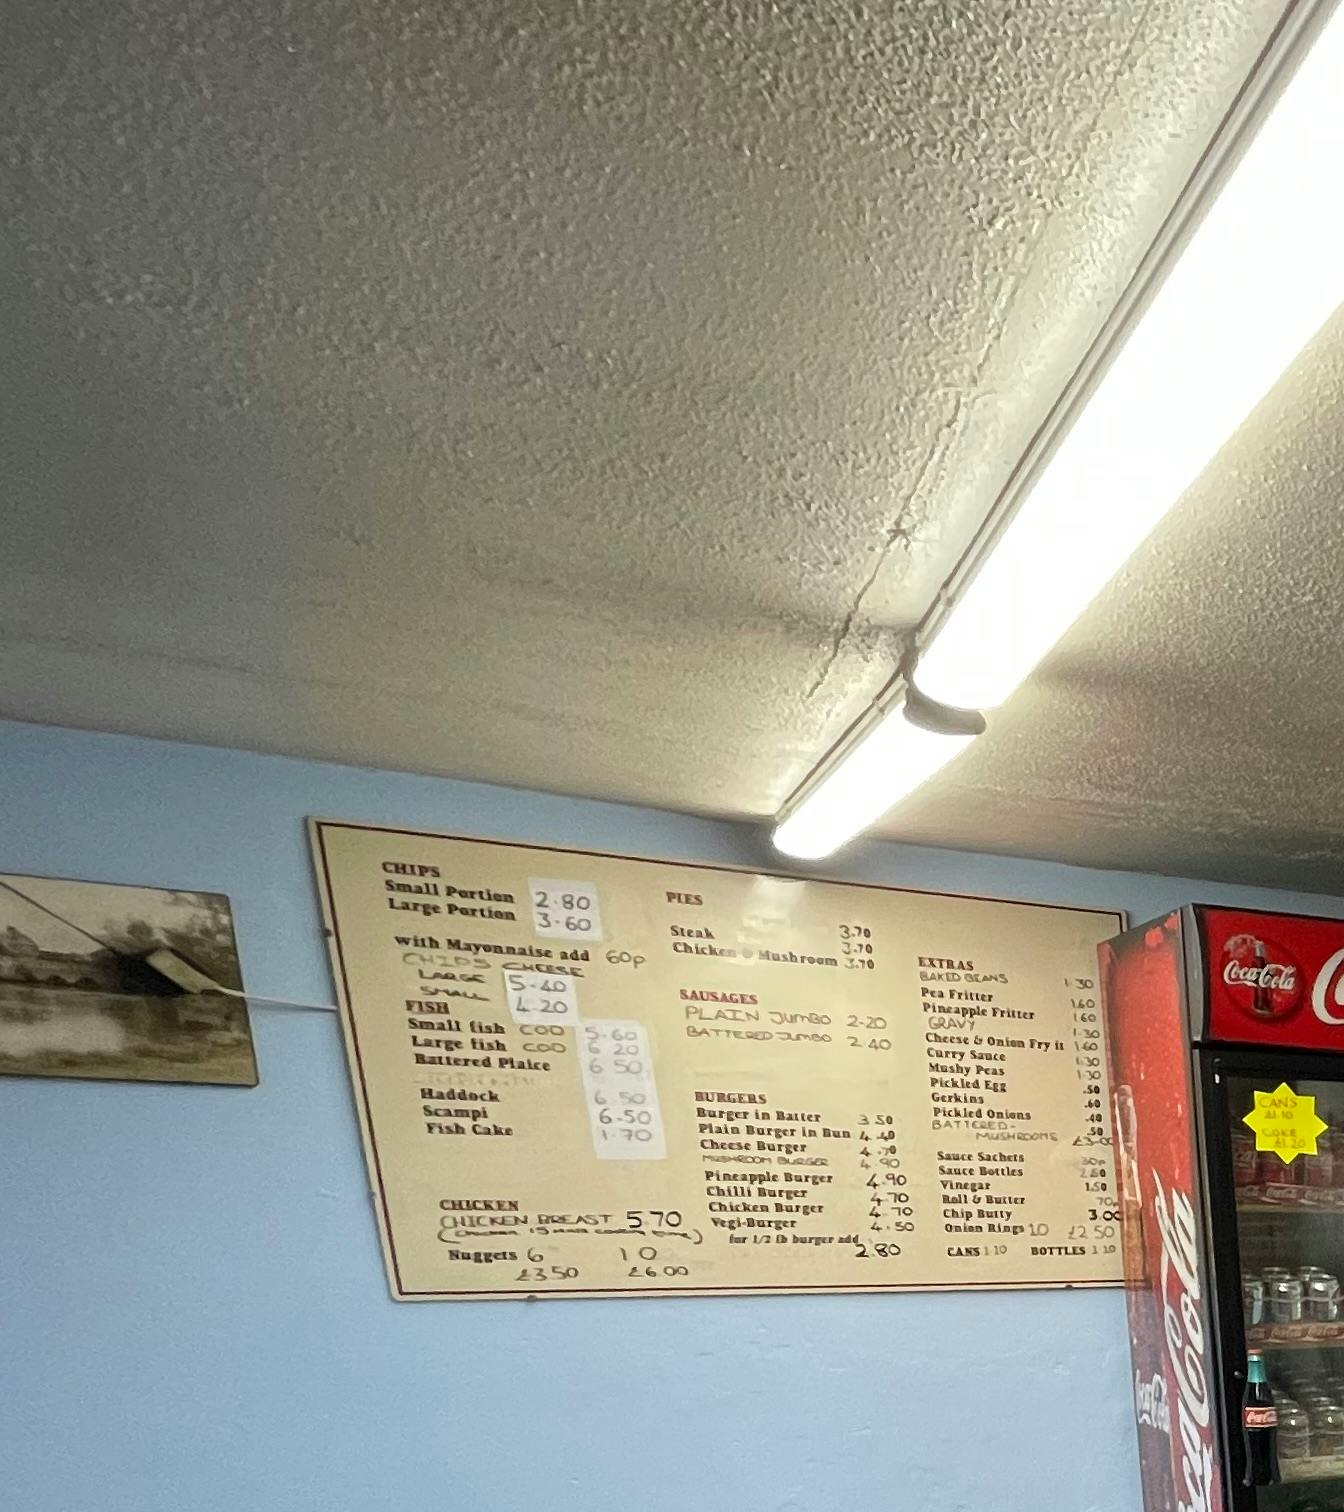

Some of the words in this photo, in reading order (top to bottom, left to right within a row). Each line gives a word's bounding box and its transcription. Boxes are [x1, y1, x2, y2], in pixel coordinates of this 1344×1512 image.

[382, 862, 441, 877] CHIPS
[385, 880, 438, 896] Small
[447, 886, 514, 903] Portion
[666, 891, 703, 905] PIES
[389, 898, 441, 916] Large
[447, 904, 516, 921] Portion
[670, 925, 715, 939] Steak
[394, 934, 439, 949] with
[447, 939, 552, 959] Mayonnaise
[560, 949, 590, 961] add
[606, 950, 646, 968] 60p
[673, 942, 737, 957] Chicken
[758, 950, 837, 966] Mushroom
[919, 957, 974, 971] EXTRAS
[920, 972, 961, 982] BAKED
[964, 973, 1008, 984] BEANS
[1223, 959, 1296, 992] Coca-Cola
[680, 989, 758, 1004] SAUSAGES
[921, 987, 944, 998] Pea
[949, 989, 993, 1002] Fritter
[405, 1000, 450, 1014] FISH
[686, 1006, 760, 1022] PLAIN
[923, 1002, 988, 1018] Pineapple
[992, 1008, 1035, 1020] Fritter
[407, 1018, 460, 1031] Small
[469, 1021, 505, 1034] fish
[929, 1016, 975, 1031] GRAVY
[687, 1025, 773, 1040] BATTERED
[411, 1036, 464, 1051] Large
[471, 1037, 507, 1052] fish
[926, 1032, 969, 1044] Cheese
[974, 1036, 983, 1045] &
[988, 1036, 1025, 1048] Onion
[1030, 1038, 1050, 1052] Fry
[927, 1048, 965, 1060] Curry
[970, 1050, 1006, 1061] Sauce
[414, 1053, 491, 1068] Battered
[498, 1057, 550, 1071] Plaice
[929, 1062, 971, 1076] Mushy
[976, 1065, 1005, 1076] Peas
[930, 1077, 980, 1089] Pickled
[984, 1080, 1006, 1093] Egg
[420, 1088, 500, 1102] Haddock
[695, 1092, 767, 1104] BURGERS
[931, 1092, 984, 1104] Gerkins
[1259, 1098, 1297, 1108] CANS
[423, 1105, 488, 1120] Scampi
[696, 1107, 749, 1121] Burger
[755, 1110, 770, 1120] in
[776, 1111, 821, 1122] Batter
[933, 1107, 982, 1119] Pickled
[987, 1109, 1031, 1120] Onions
[426, 1123, 465, 1135] Fish
[472, 1124, 513, 1136] Cake
[699, 1124, 740, 1135] Plain
[746, 1125, 796, 1138] Burger
[801, 1128, 816, 1137] in
[823, 1128, 850, 1138] Bun
[976, 1133, 1058, 1141] MUSHROOMS
[700, 1139, 751, 1150] Cheese
[757, 1141, 807, 1154] Burger
[937, 1151, 973, 1161] Sauce
[978, 1152, 1024, 1162] Sachets
[705, 1171, 778, 1184] Pineapple
[784, 1172, 833, 1185] Burger
[939, 1166, 974, 1175] Sauce
[979, 1166, 1023, 1176] Bottles
[706, 1186, 751, 1197] Chilli
[758, 1187, 808, 1200] Burger
[940, 1180, 991, 1192] Vinegar
[440, 1200, 518, 1211] CHICKEN
[942, 1195, 968, 1204] Roll
[973, 1195, 981, 1204] &
[985, 1195, 1025, 1204] Butter
[709, 1202, 769, 1213] Chicken
[775, 1203, 824, 1215] Burger
[943, 1209, 972, 1220] Chip
[977, 1209, 1012, 1220] Butty
[441, 1215, 528, 1229] CHICKEN
[537, 1215, 614, 1225] BREAST
[711, 1218, 797, 1230] Vegi-Burger
[945, 1223, 983, 1233] Onion
[988, 1223, 1024, 1235] Rings
[729, 1234, 747, 1244] for
[752, 1235, 771, 1244] 1/2
[776, 1235, 788, 1244] lb
[793, 1234, 834, 1246] burger
[838, 1234, 859, 1244] add
[448, 1250, 517, 1262] Nuggets
[527, 1248, 544, 1262] 6
[947, 1247, 980, 1257] CANS
[1031, 1247, 1085, 1255] BOTTLES
